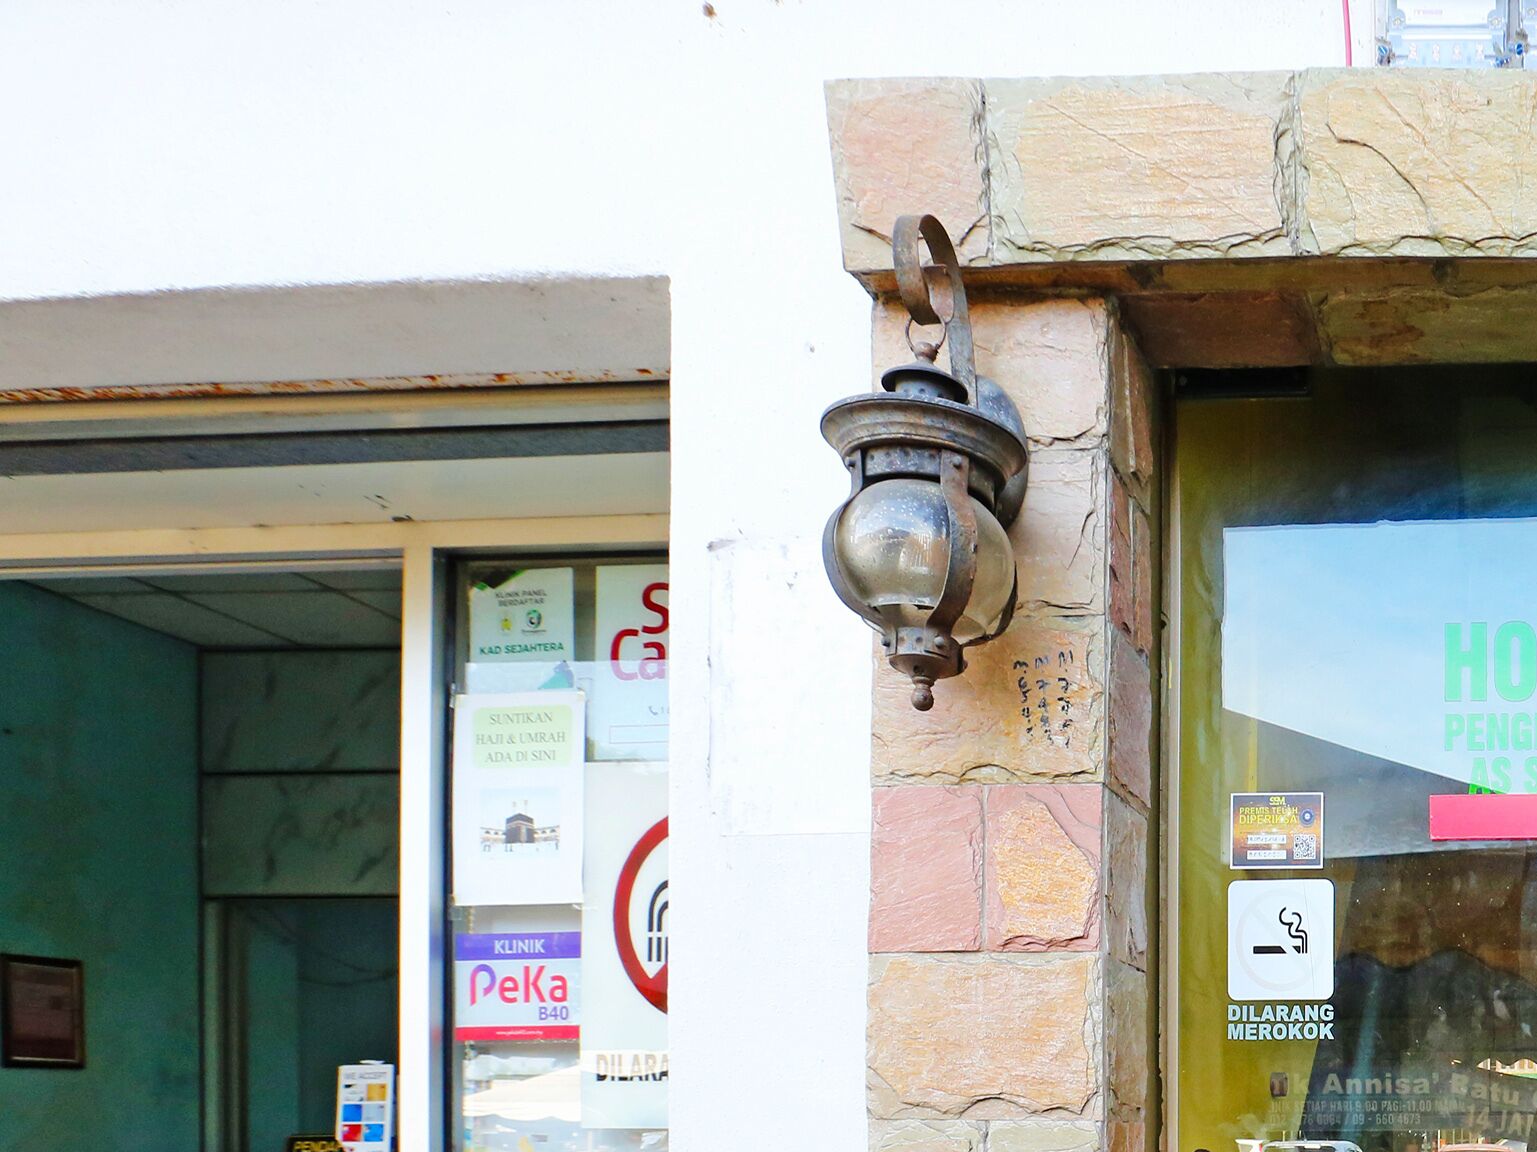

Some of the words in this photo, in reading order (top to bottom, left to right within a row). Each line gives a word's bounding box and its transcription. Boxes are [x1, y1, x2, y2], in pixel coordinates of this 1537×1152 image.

[479, 644, 502, 656] KAD
[504, 642, 565, 655] SEJAHTERA
[489, 711, 554, 725] SUNTIKAN
[476, 733, 505, 746] HAJI
[506, 734, 517, 745] &
[519, 731, 566, 744] UMRAH
[485, 751, 513, 763] ADA
[516, 751, 529, 763] DI
[531, 749, 557, 762] SINI
[1467, 756, 1512, 795] AS
[1239, 807, 1270, 815] PREMIS
[1239, 814, 1298, 824] DIPERIKSA
[493, 938, 546, 956] KLINIK
[469, 963, 569, 1007] PeKa
[538, 1005, 570, 1022] B40
[1227, 1003, 1336, 1023] DILARANG
[1227, 1022, 1336, 1041] MEROKOK
